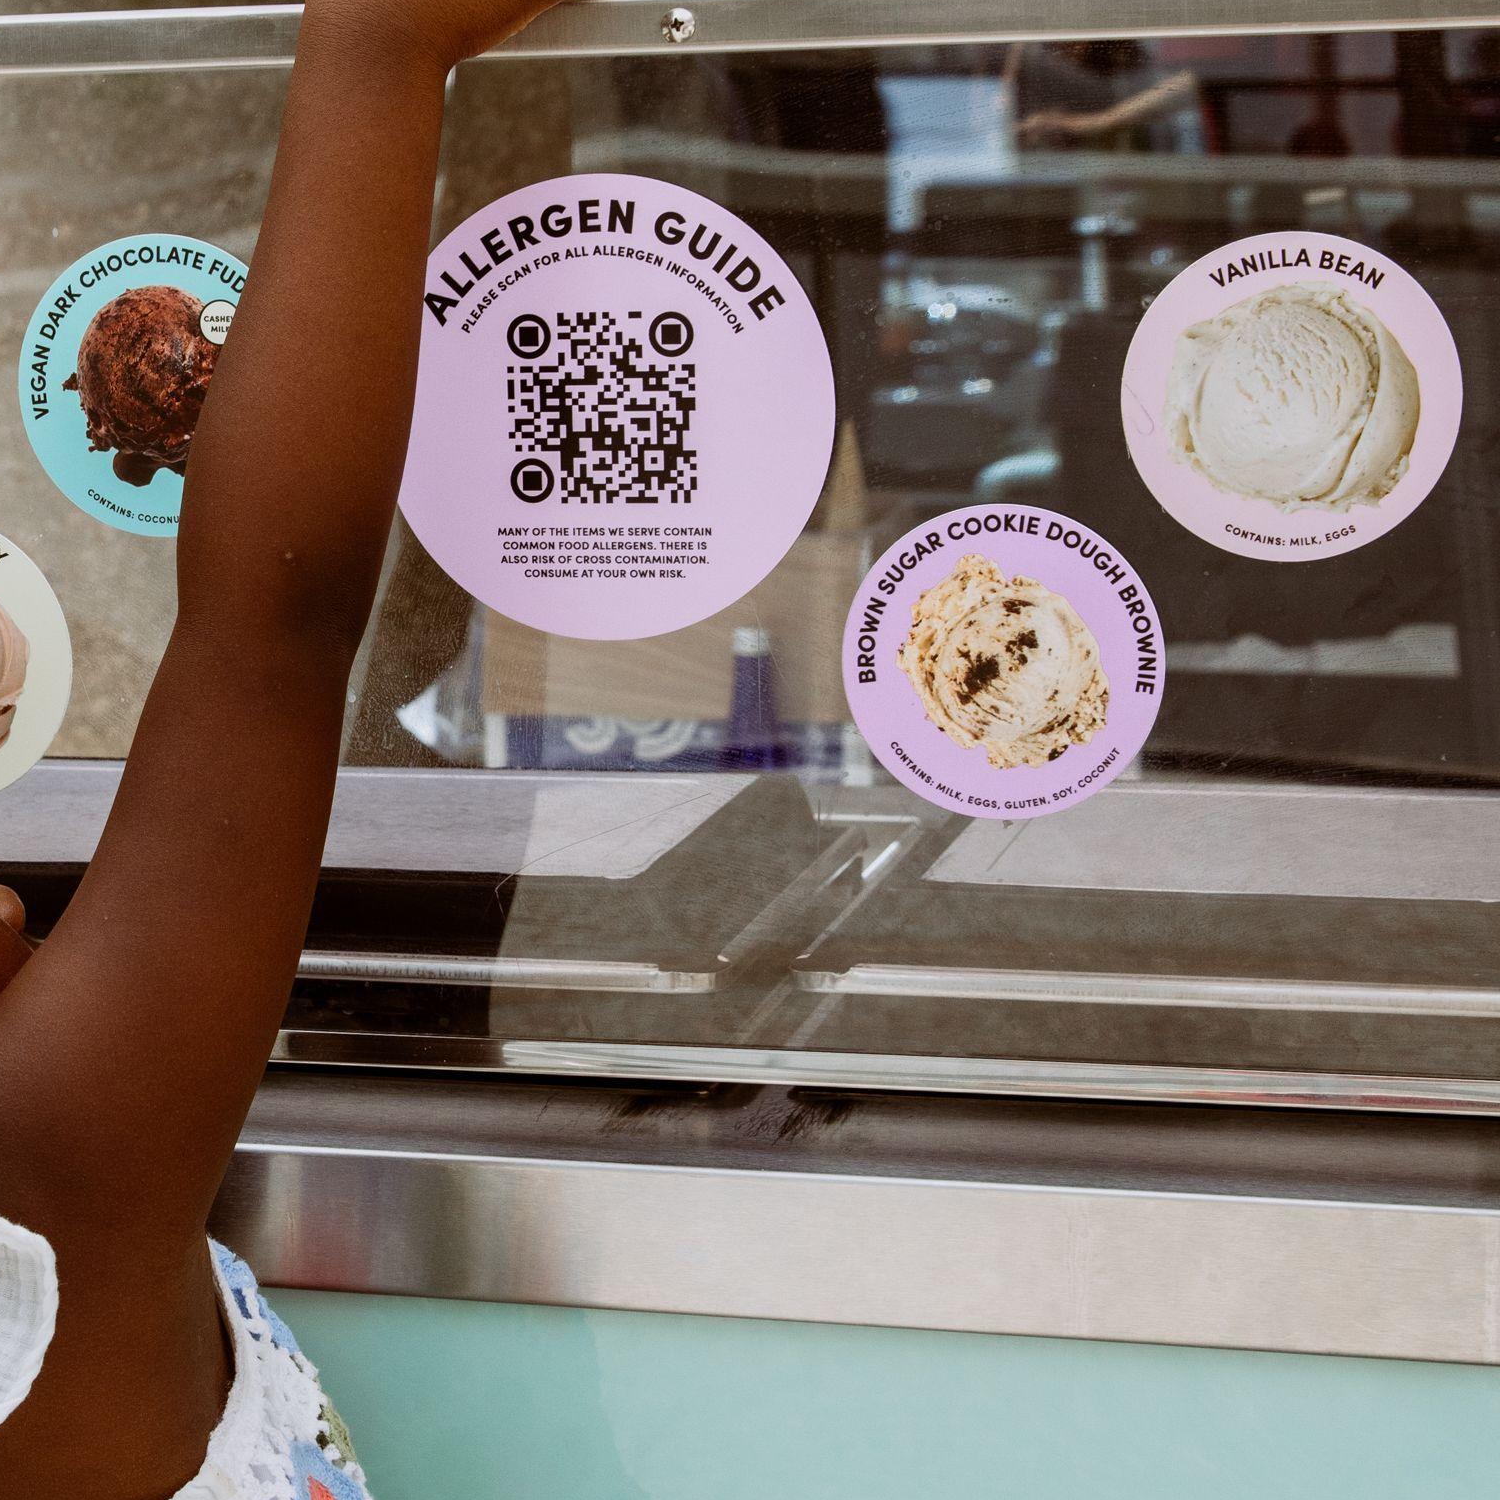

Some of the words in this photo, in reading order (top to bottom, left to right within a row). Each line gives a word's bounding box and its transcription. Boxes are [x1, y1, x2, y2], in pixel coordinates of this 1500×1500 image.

[424, 198, 635, 327] ALLERGEN
[654, 210, 786, 321] GUIDE
[1208, 248, 1312, 289] VANILLA
[1318, 249, 1386, 291] BEAN
[461, 289, 499, 335] PLEASE
[497, 263, 533, 292] SCAN
[534, 251, 561, 271] FOR
[564, 245, 589, 261] ALL
[592, 244, 665, 268] ALLERGEN
[665, 259, 745, 335] INFORMATION
[30, 344, 52, 421] VEGAN
[41, 284, 82, 341] DARK
[79, 245, 206, 289] CHOCOLATE
[87, 488, 135, 519] CONTAINS:
[497, 527, 529, 537] MANY
[531, 527, 547, 537] OF
[549, 527, 570, 537] THE
[572, 527, 606, 537] ITEMS
[607, 527, 625, 537] WE
[627, 527, 661, 537] SERVE
[663, 527, 713, 537] CONTAIN
[502, 541, 556, 551] COMMON
[558, 541, 590, 551] FOOD
[592, 541, 657, 551] ALLERGENS.
[659, 541, 694, 551] THERE
[697, 541, 708, 551] IS
[1224, 522, 1287, 548] CONTAINS:
[1289, 535, 1322, 548] MILK,
[1325, 524, 1357, 544] EGGS
[500, 555, 529, 565] ALSO
[531, 555, 556, 565] RISK
[557, 555, 573, 565] OF
[575, 555, 612, 565] CROSS
[614, 555, 710, 565] CONTAMINATION.
[524, 569, 579, 579] CONSUME
[580, 569, 594, 579] AT
[596, 569, 627, 579] YOUR
[629, 569, 656, 579] OWN
[658, 569, 687, 579] RISK.
[857, 596, 888, 685] BROWN
[877, 531, 946, 596] SUGAR
[947, 513, 1042, 541] COOKIE
[1045, 521, 1127, 587] DOUGH
[1117, 583, 1158, 696] BROWNIE
[889, 740, 936, 788] CONTAINS:
[935, 782, 965, 803] MILK,
[967, 795, 1001, 811] EGGS,
[1004, 795, 1051, 811] GLUTEN,
[1052, 785, 1078, 805] SOY,
[1077, 746, 1122, 790] COCONUT
